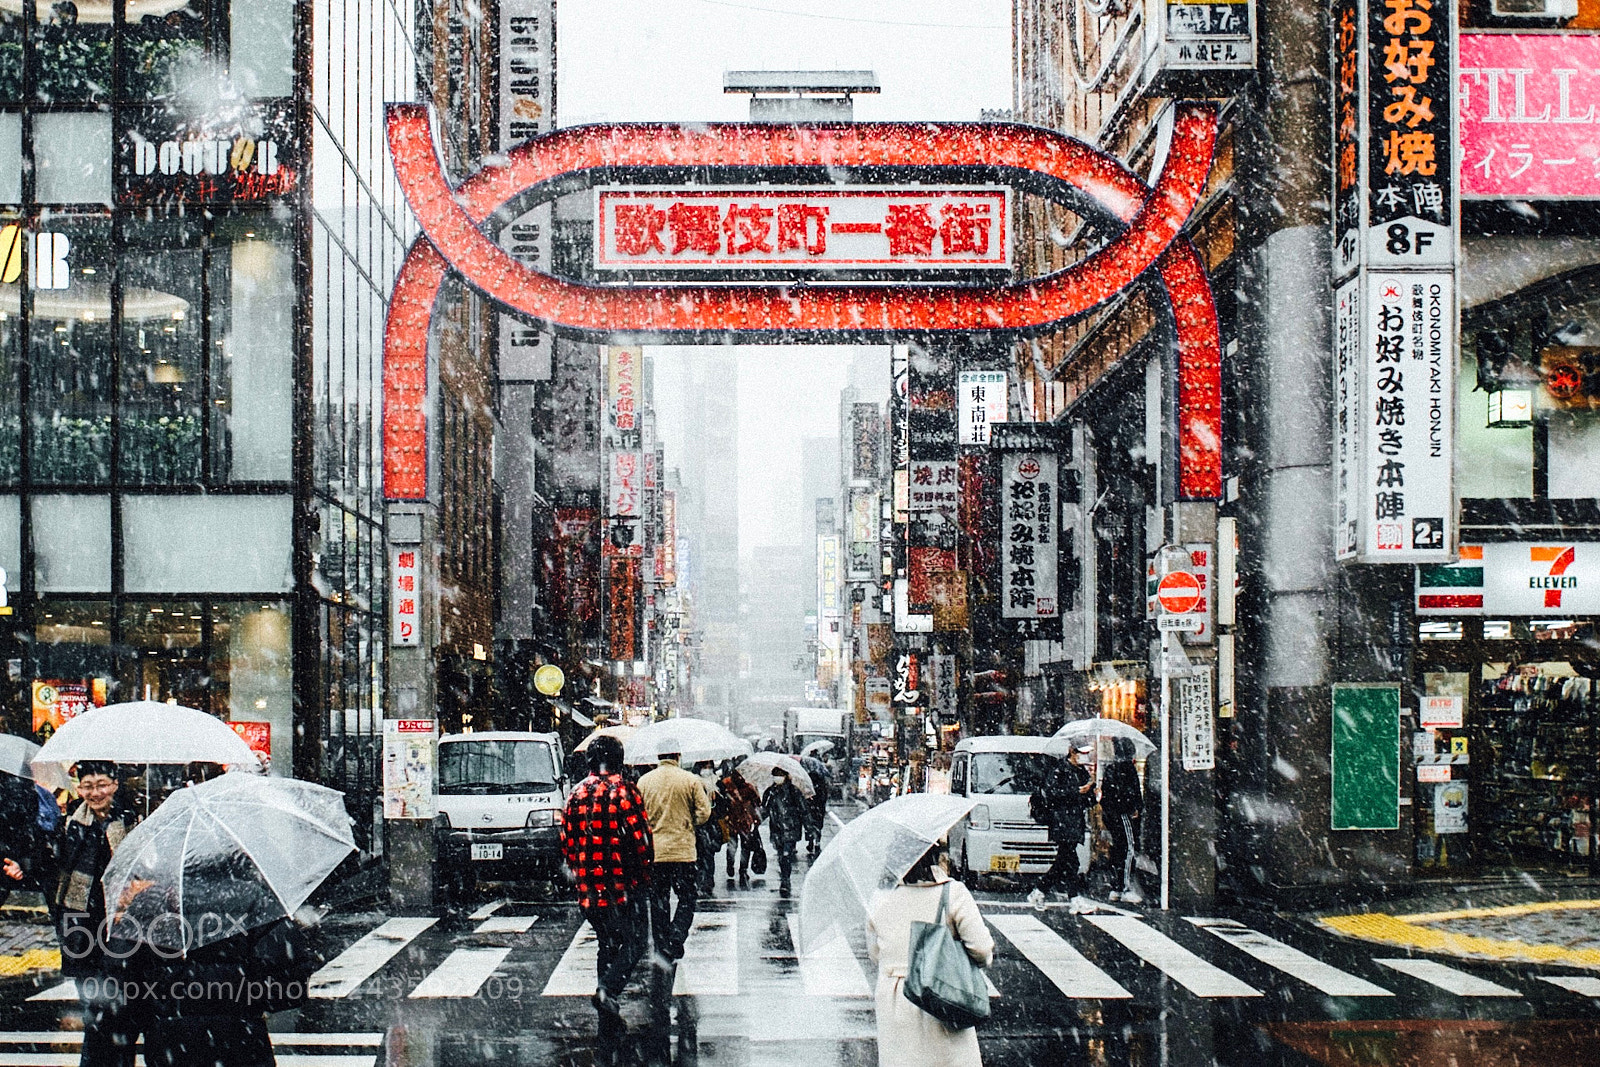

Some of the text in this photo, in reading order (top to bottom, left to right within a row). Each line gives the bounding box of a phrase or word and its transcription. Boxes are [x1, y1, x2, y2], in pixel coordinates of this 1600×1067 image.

[1383, 0, 1437, 176] お好み焼
[1459, 68, 1600, 123] FILL
[135, 137, 278, 176] DOUTOR
[1459, 144, 1600, 179] ィラー
[1377, 183, 1443, 214] 本陣
[614, 202, 991, 256] 歌舞伎町一番街
[1386, 223, 1435, 255] 8F
[1429, 284, 1441, 457] OKONOMIYAKI HONJIN
[971, 385, 986, 443] 東南荘
[1376, 304, 1406, 521] お好み焼き本陣
[1415, 522, 1442, 545] 2F
[398, 551, 415, 637] 劇場通り
